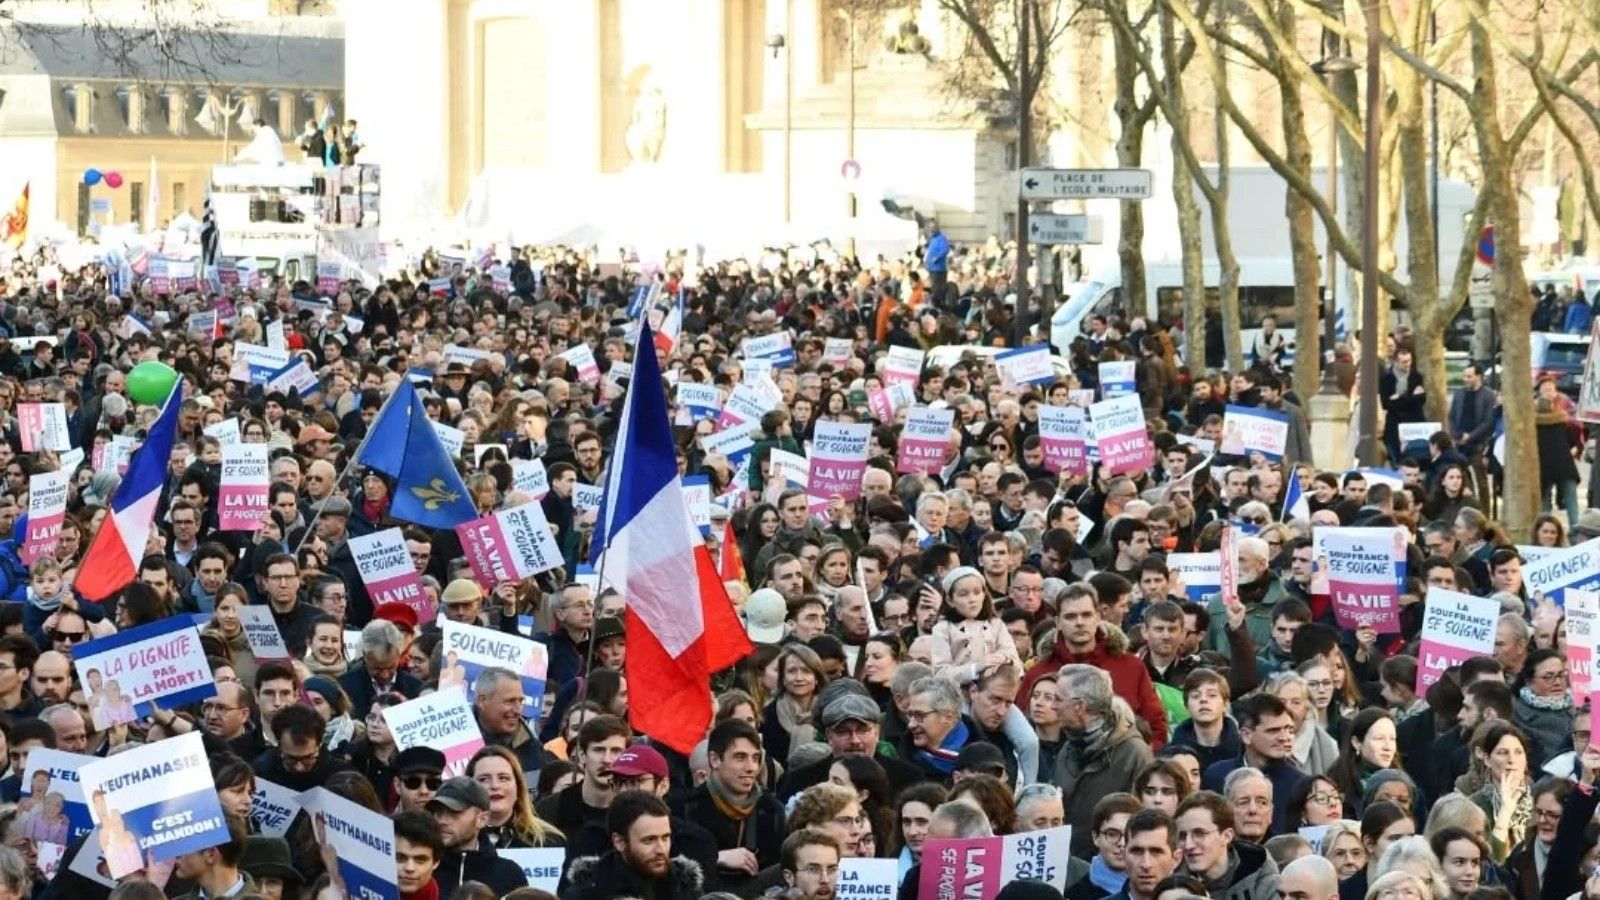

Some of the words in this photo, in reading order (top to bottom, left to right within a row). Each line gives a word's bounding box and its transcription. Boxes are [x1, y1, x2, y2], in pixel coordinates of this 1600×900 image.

[1053, 174, 1086, 182] PLACE
[1091, 174, 1104, 182] DE
[1098, 186, 1147, 194] MILITAIRE
[906, 445, 922, 455] LA
[924, 447, 942, 456] VIE
[1046, 444, 1060, 456] LA
[1060, 447, 1082, 457] VIE
[1104, 443, 1122, 456] LA
[1122, 438, 1145, 450] VIE
[815, 466, 834, 478] LA
[836, 469, 860, 480] VIE
[224, 494, 244, 506] LA
[246, 494, 269, 506] VIE
[577, 492, 602, 506] SOIG
[32, 528, 48, 540] LA
[535, 530, 546, 542] LA
[372, 540, 382, 549] LA
[478, 524, 496, 550] LA
[488, 549, 508, 582] VIE
[1329, 551, 1390, 560] SOUFFRANCE
[1330, 560, 1342, 571] SE
[374, 591, 395, 604] LA
[393, 583, 420, 601] VIE
[1336, 590, 1358, 606] LA
[1360, 595, 1392, 608] VIE
[1457, 602, 1468, 612] LA
[1428, 616, 1443, 630] SE
[1430, 606, 1493, 627] SOUFFRANCE
[104, 657, 123, 677] LA
[1424, 652, 1448, 671] LA
[152, 664, 177, 679] PAS
[134, 684, 154, 698] LA
[155, 672, 196, 692] MORT
[420, 704, 434, 714] LA
[395, 705, 465, 734] SOUFFRANCE
[99, 754, 200, 794] L'EUTHANASIE
[252, 798, 292, 816] RANCE
[152, 810, 193, 830] C'EST
[140, 820, 214, 850] L'ABANDON
[1018, 836, 1034, 857] SE
[942, 848, 957, 864] SE
[964, 848, 986, 880] LA
[842, 870, 858, 881] LA
[1046, 866, 1056, 882] LA
